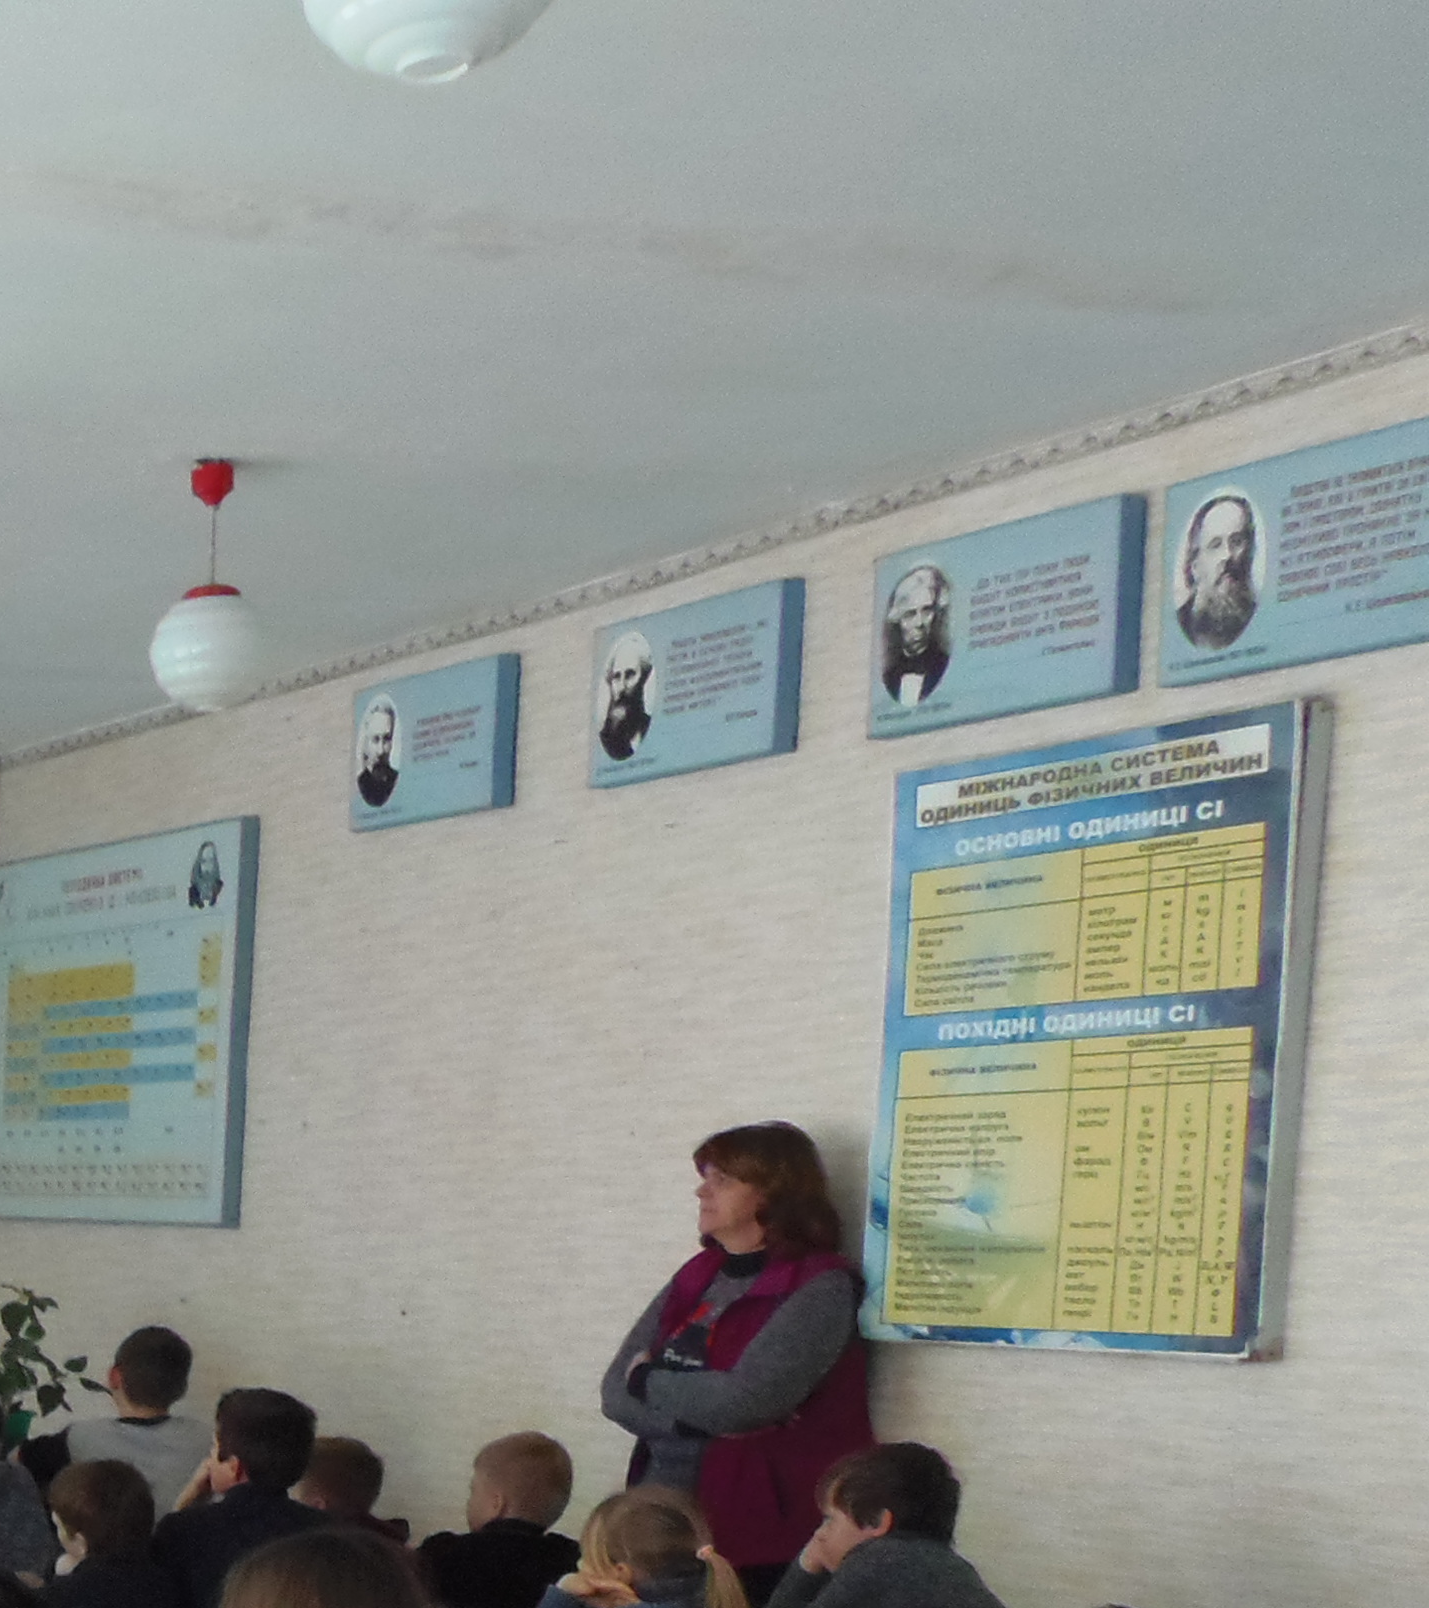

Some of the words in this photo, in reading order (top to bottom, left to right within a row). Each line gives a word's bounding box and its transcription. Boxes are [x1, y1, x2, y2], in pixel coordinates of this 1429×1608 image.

[919, 796, 1022, 825] ОДИНИЦЬ
[1026, 776, 1142, 807] ФІЗИЧНИХ
[1148, 752, 1264, 788] ВЕЛИЧИН
[956, 759, 1104, 799] МІЖНАРОДНА
[1110, 738, 1221, 772] СИСТЕМА
[954, 823, 1062, 856] ОСНОВНІ
[1067, 804, 1189, 841] ОДИНИЦІ
[1195, 799, 1224, 822] СІ
[937, 1015, 1037, 1041] ПОХІДНІ
[1042, 1005, 1161, 1036] ОДИНИЦІ
[1167, 1003, 1196, 1023] СІ
